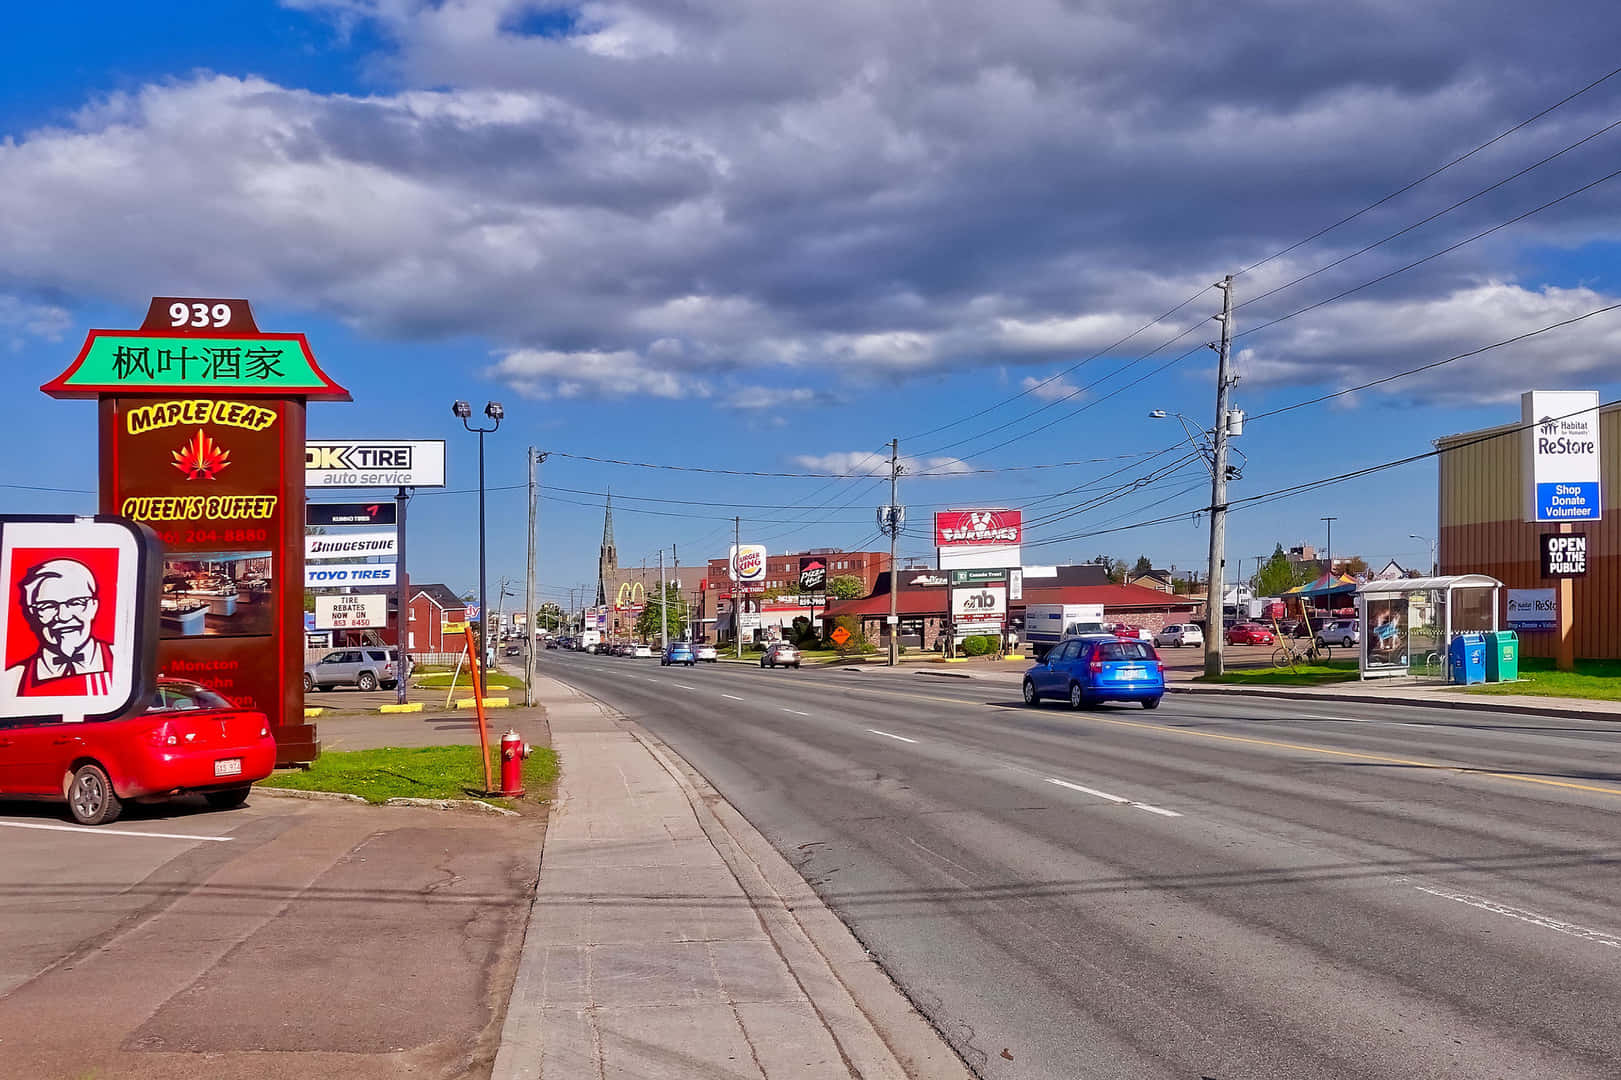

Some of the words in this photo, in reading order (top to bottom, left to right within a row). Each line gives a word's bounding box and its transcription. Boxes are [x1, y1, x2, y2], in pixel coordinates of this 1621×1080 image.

[169, 303, 231, 327] 939
[112, 346, 285, 379] 枫叶酒家
[128, 400, 213, 434] MAPLE
[212, 401, 277, 431] LEAF
[1561, 421, 1588, 430] Habitat
[1539, 437, 1594, 454] ReStore
[358, 450, 407, 466] TIRE
[324, 473, 357, 484] auto
[360, 471, 412, 484] service
[1556, 485, 1581, 496] Shop
[1552, 496, 1585, 505] Donate
[122, 496, 204, 521] QUEEN'S
[206, 496, 277, 520] BUFFET
[1546, 507, 1591, 516] Volunteer
[311, 540, 394, 552] BRIDGESTONE
[1549, 538, 1586, 551] OPEN
[1549, 552, 1563, 562] TO
[1565, 552, 1585, 562] THE
[1550, 562, 1585, 573] PUBLIC
[351, 570, 391, 579] TIRES
[171, 660, 239, 672] Moncton
